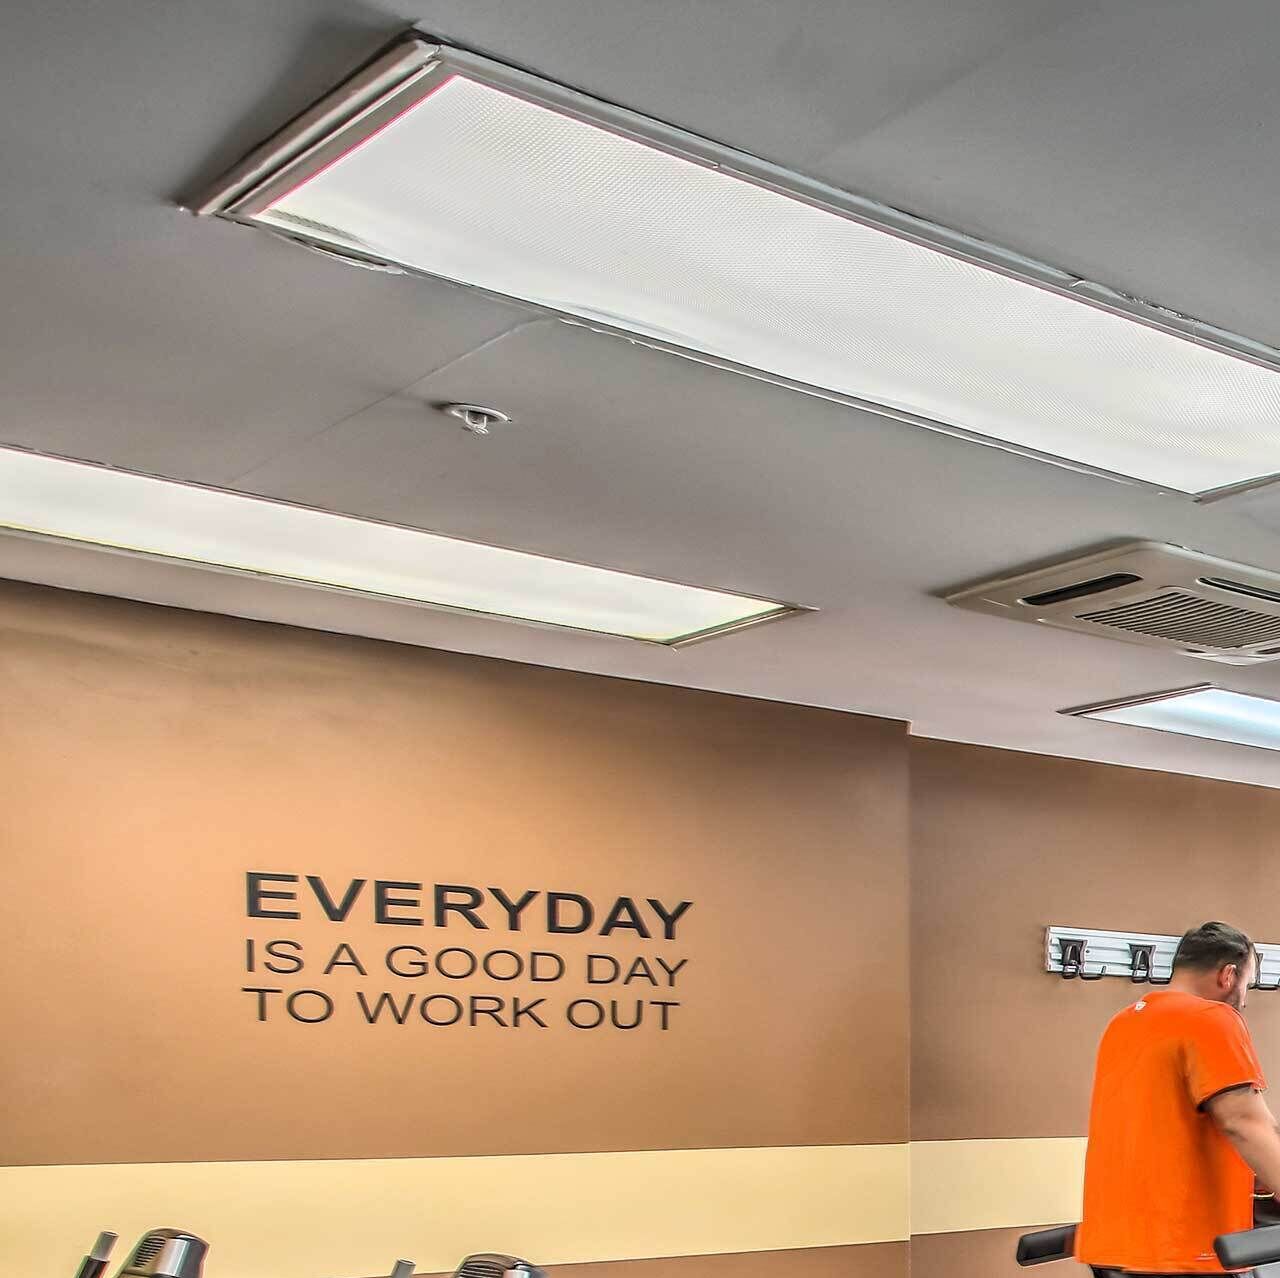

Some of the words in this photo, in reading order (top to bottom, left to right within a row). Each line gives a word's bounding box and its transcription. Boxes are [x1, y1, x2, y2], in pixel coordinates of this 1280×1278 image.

[245, 871, 694, 941] EVERYDAY
[245, 937, 304, 975] IS
[322, 942, 368, 977] A
[386, 944, 566, 983] GOOD
[586, 953, 689, 988] DAY
[242, 986, 334, 1025] TO
[356, 991, 548, 1028] WORK
[566, 998, 682, 1031] OUT
